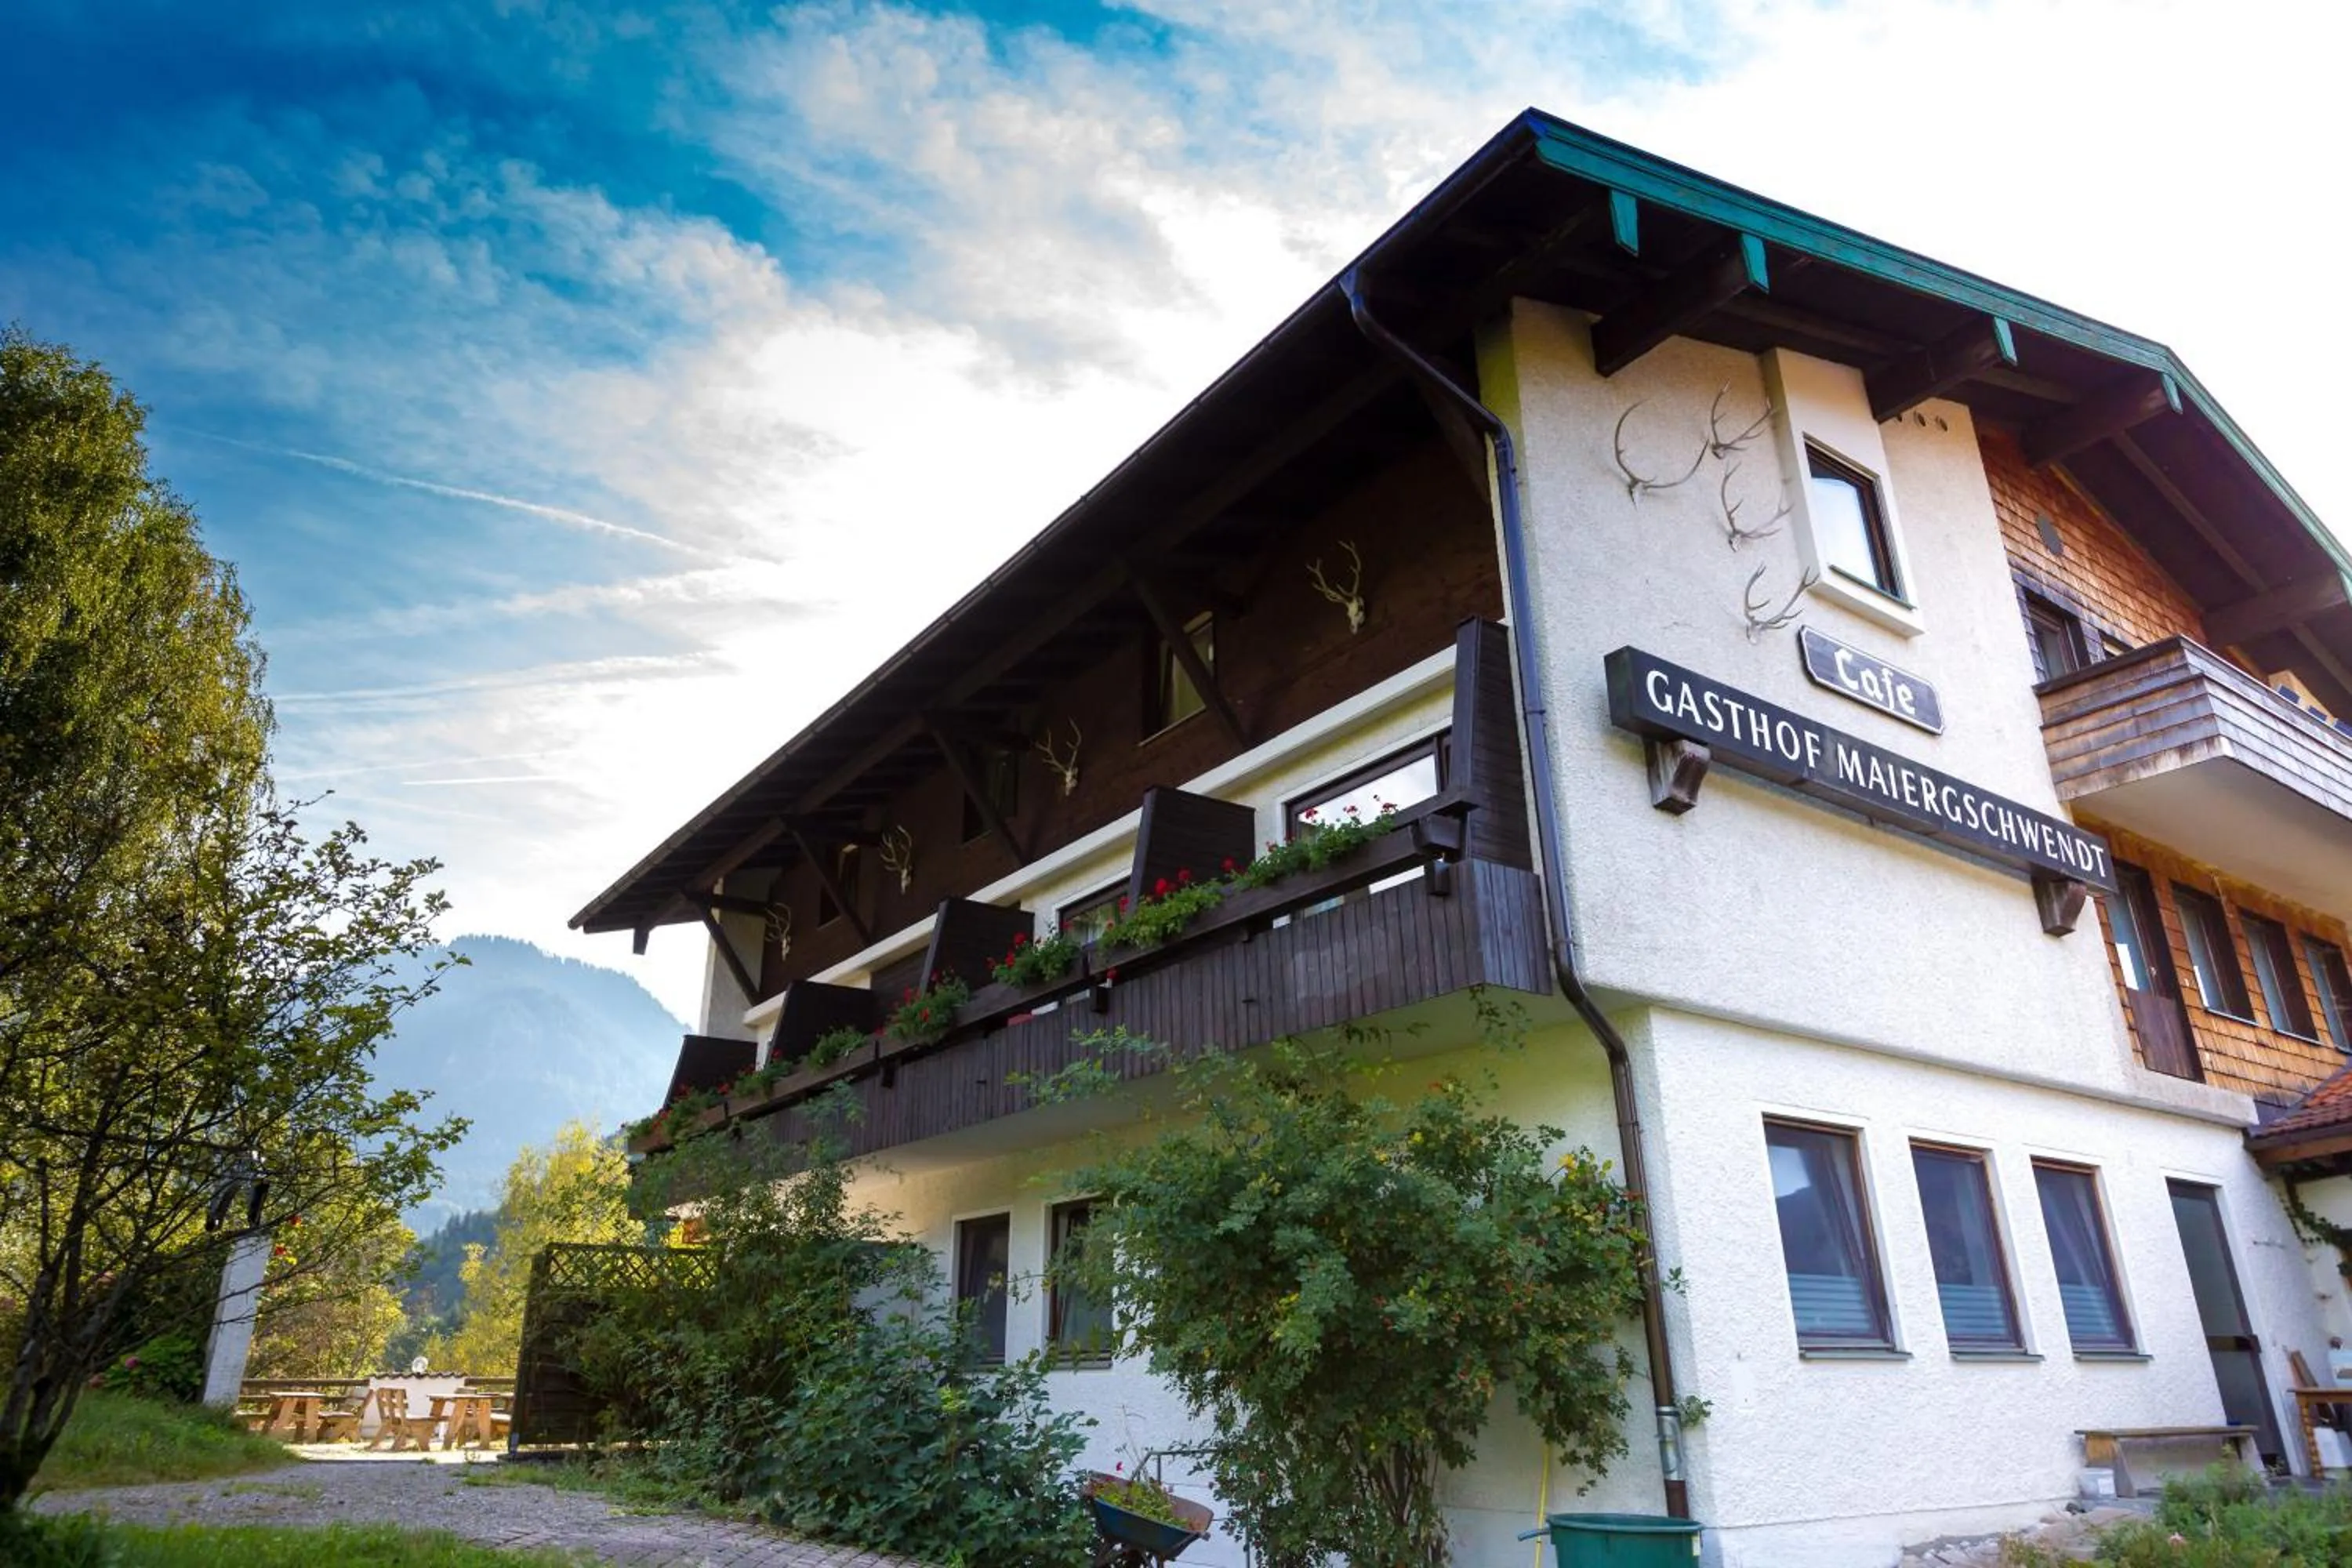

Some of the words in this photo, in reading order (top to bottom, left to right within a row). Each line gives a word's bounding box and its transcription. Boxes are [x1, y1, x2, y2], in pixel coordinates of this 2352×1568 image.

[1834, 648, 1915, 715] Cafe
[1646, 670, 1821, 768] GASTHOF
[1837, 742, 2107, 878] MAIERGSCHWENDT
